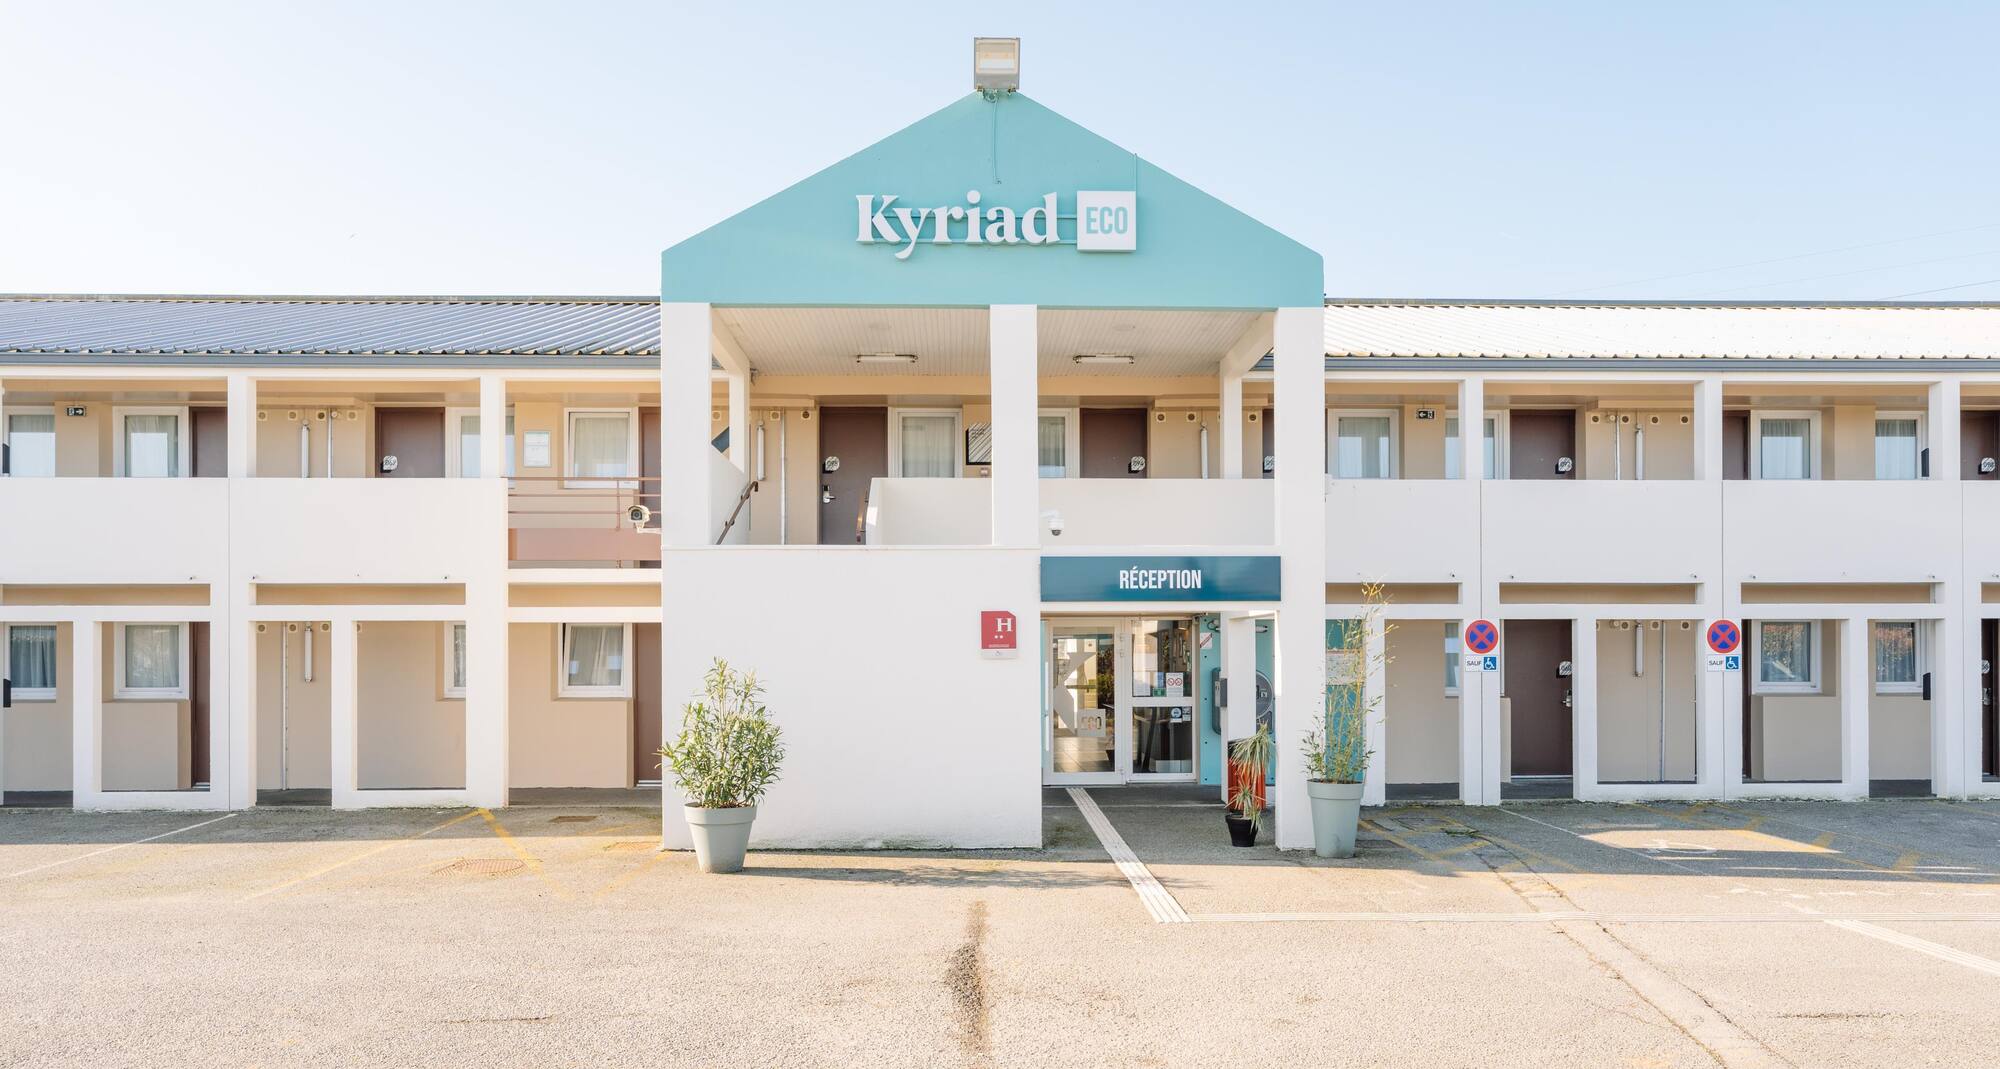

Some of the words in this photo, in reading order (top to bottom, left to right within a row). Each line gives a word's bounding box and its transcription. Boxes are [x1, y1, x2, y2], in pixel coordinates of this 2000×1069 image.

[856, 190, 1060, 260] Kyriad
[1085, 206, 1128, 235] ECO
[1119, 566, 1202, 589] RÉCEPTION
[995, 617, 1013, 632] H
